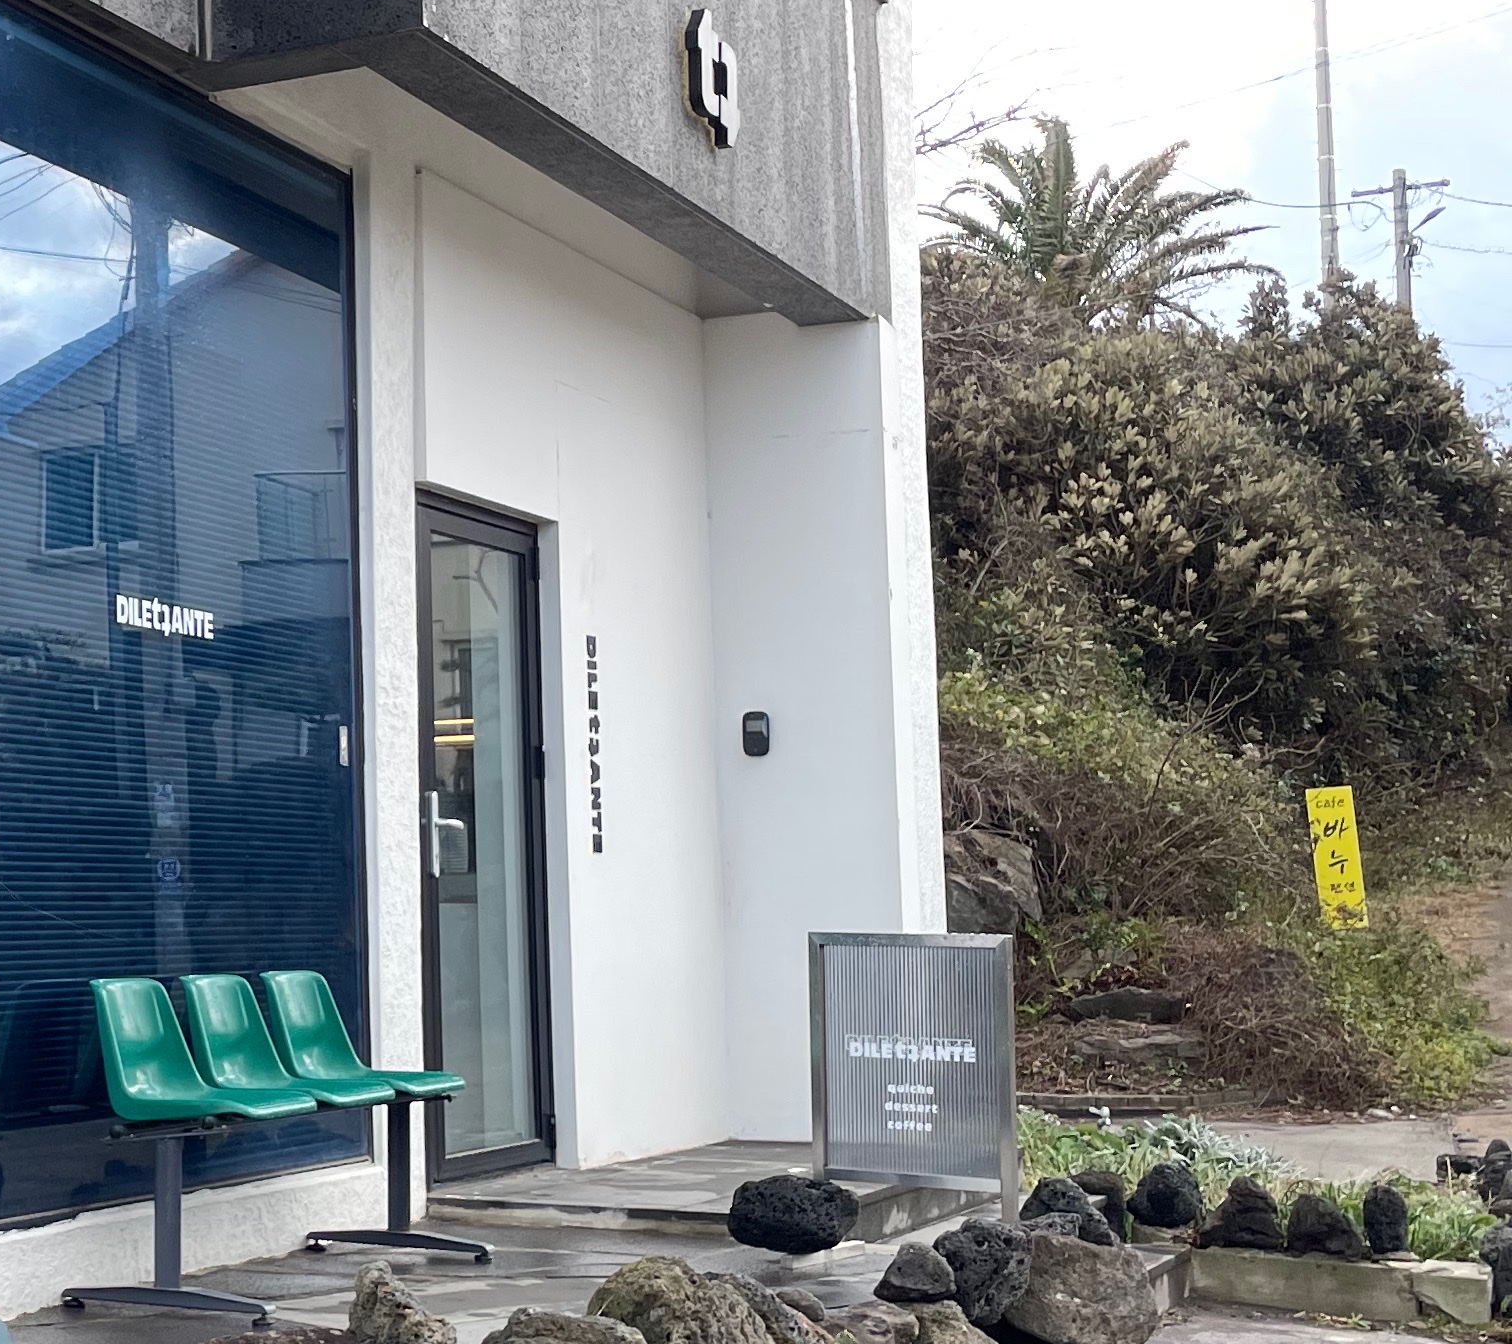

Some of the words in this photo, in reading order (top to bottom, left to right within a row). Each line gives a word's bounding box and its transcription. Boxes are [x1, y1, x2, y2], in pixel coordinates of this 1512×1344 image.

[1316, 795, 1345, 809] cafe
[884, 1100, 938, 1114] dessert
[887, 1120, 933, 1132] coffee
